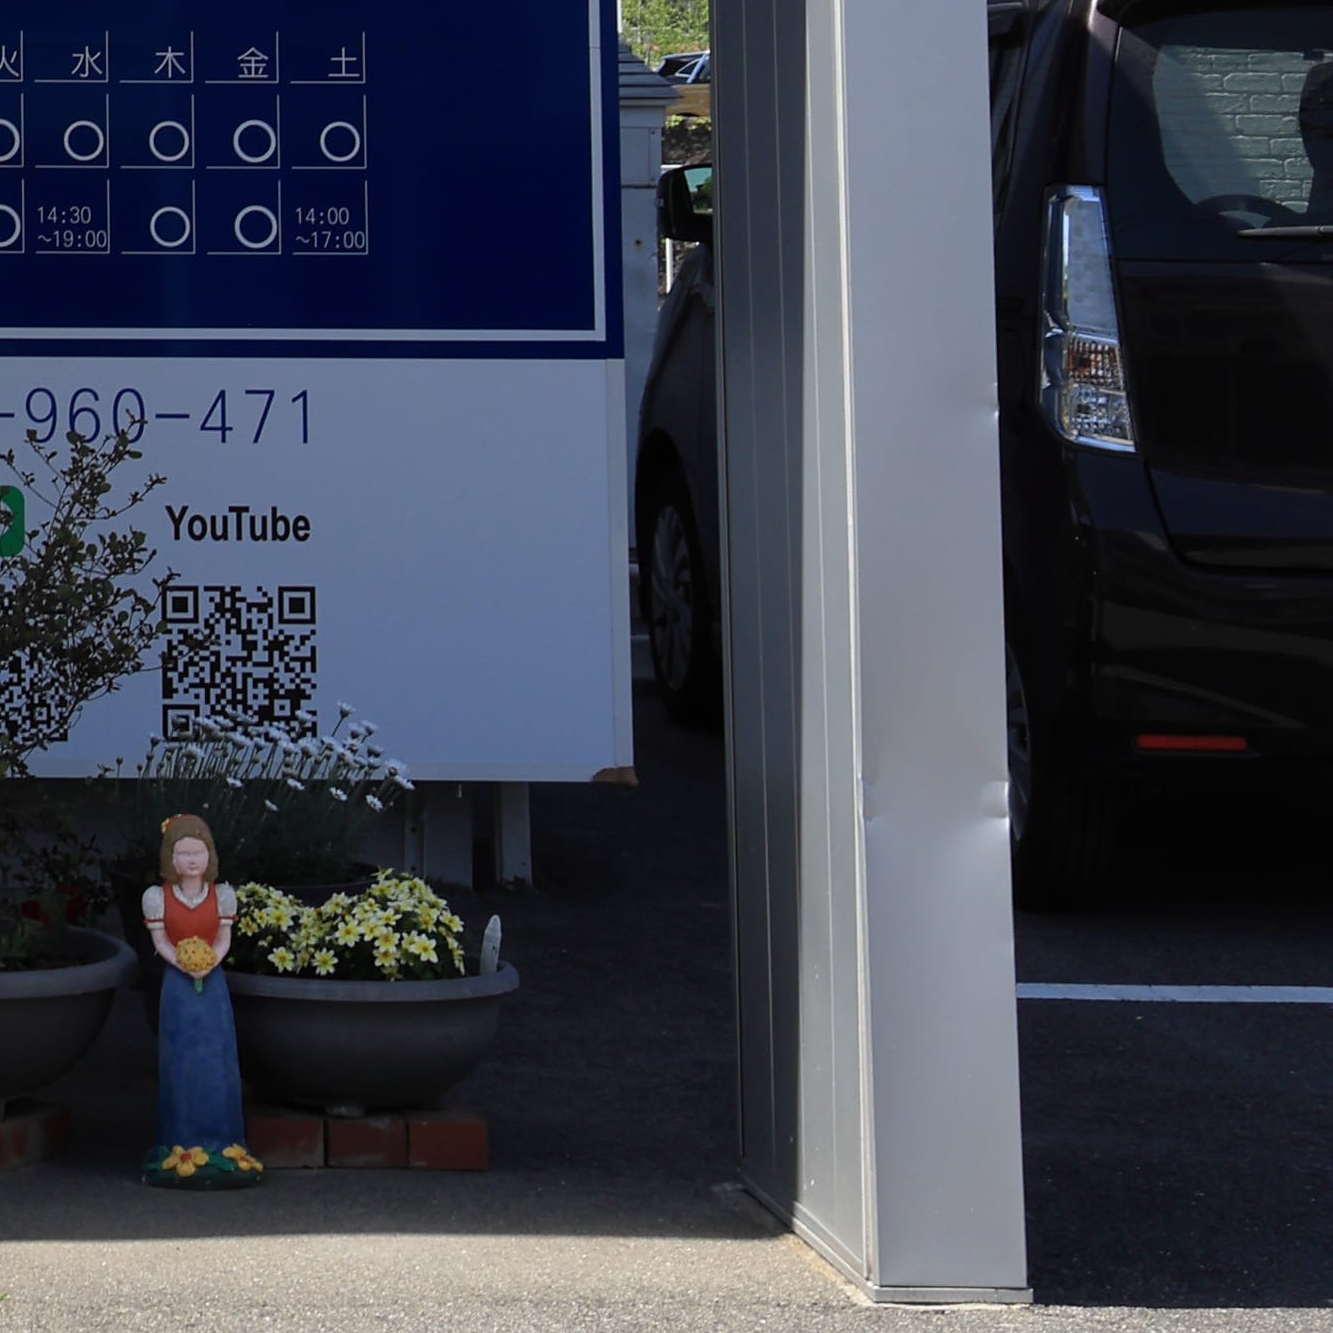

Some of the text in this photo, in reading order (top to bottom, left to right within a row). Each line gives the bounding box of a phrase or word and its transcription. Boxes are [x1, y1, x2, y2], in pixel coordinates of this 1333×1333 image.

[71, 45, 104, 78] 水
[154, 45, 186, 78] 木
[237, 46, 269, 79] 金
[328, 46, 361, 78] 土
[37, 205, 92, 225] 14:30
[295, 206, 350, 225] 14:00
[164, 505, 311, 542] YouTube
